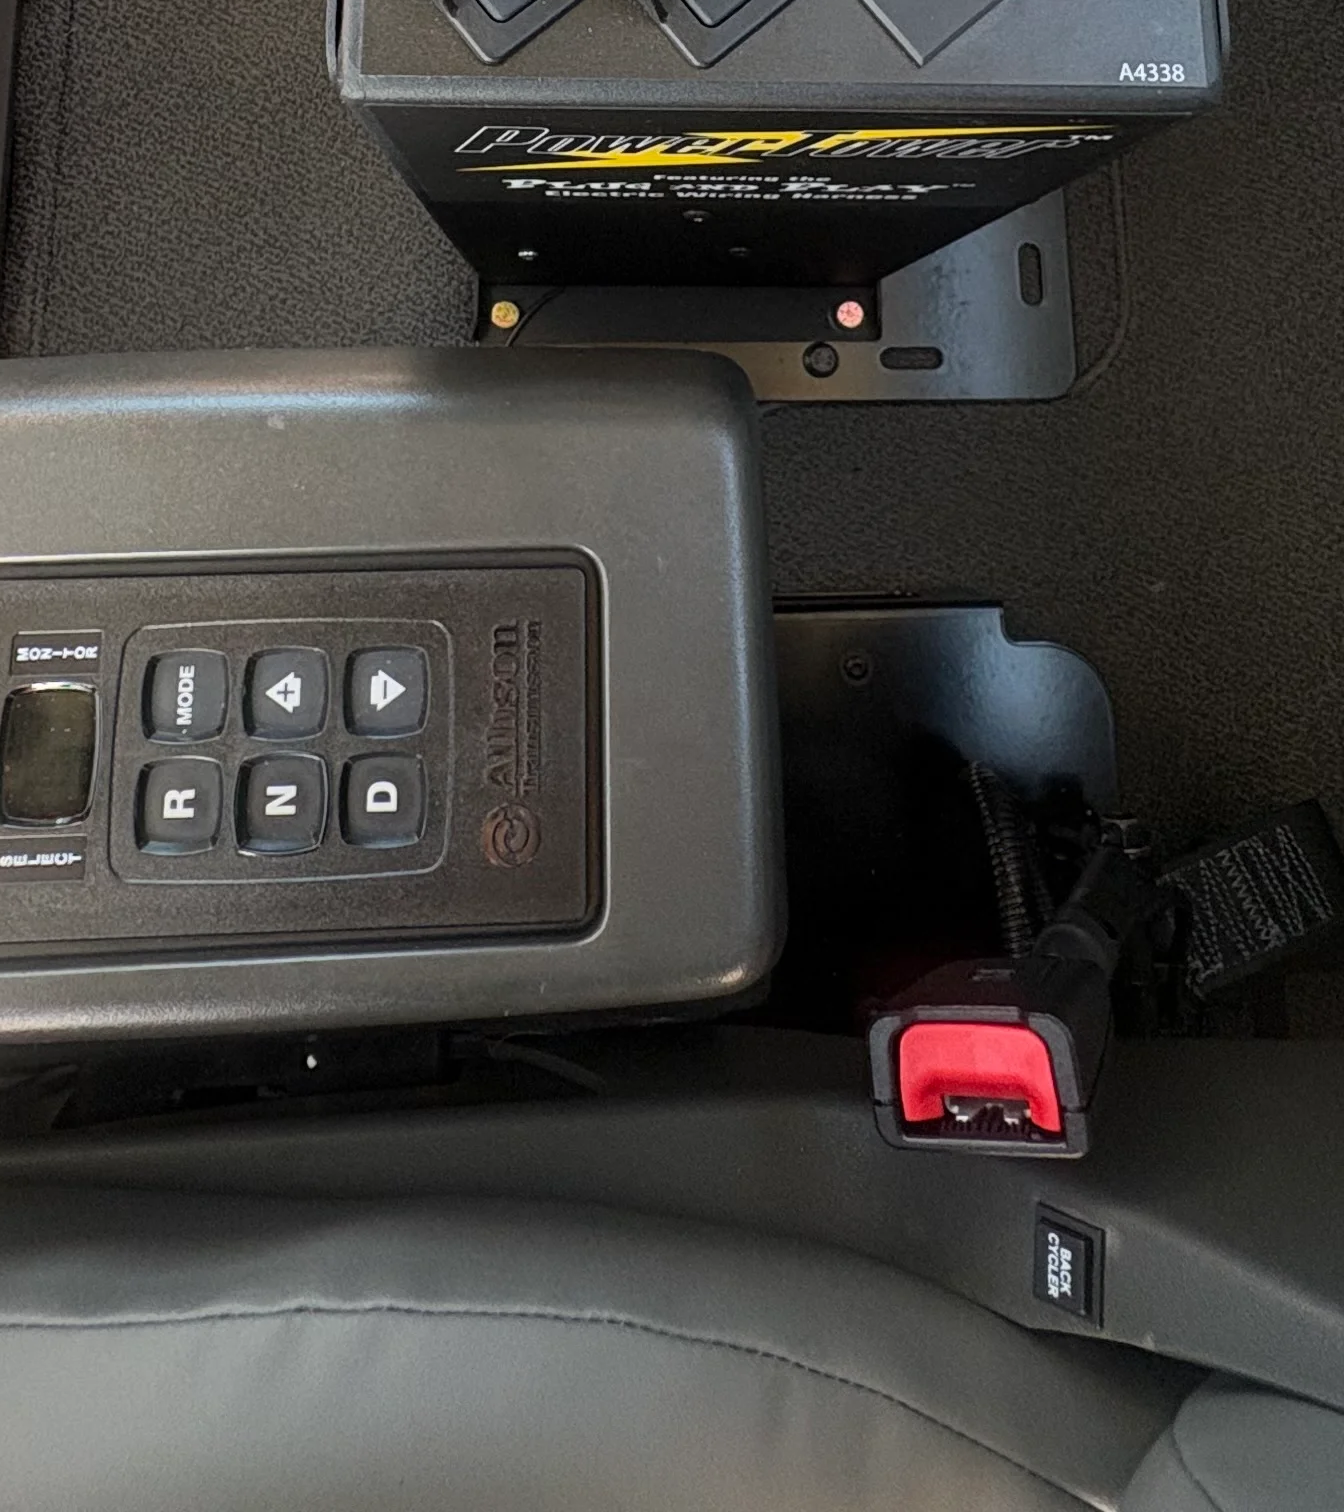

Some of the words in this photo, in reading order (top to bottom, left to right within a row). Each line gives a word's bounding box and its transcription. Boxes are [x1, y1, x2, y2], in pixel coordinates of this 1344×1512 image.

[1119, 62, 1185, 82] A4338
[502, 178, 651, 190] PLUG
[669, 182, 759, 190] AND
[654, 173, 779, 182] Featuring
[677, 191, 780, 200] Wiring
[792, 192, 917, 200] Harness
[16, 645, 99, 662] MONITOR
[176, 664, 196, 726] MODE
[163, 788, 196, 819] R
[265, 784, 298, 816] N
[366, 780, 398, 813] D
[0, 852, 82, 867] SELECT
[1047, 1232, 1060, 1298] CYCLER
[1059, 1247, 1072, 1297] BACK
